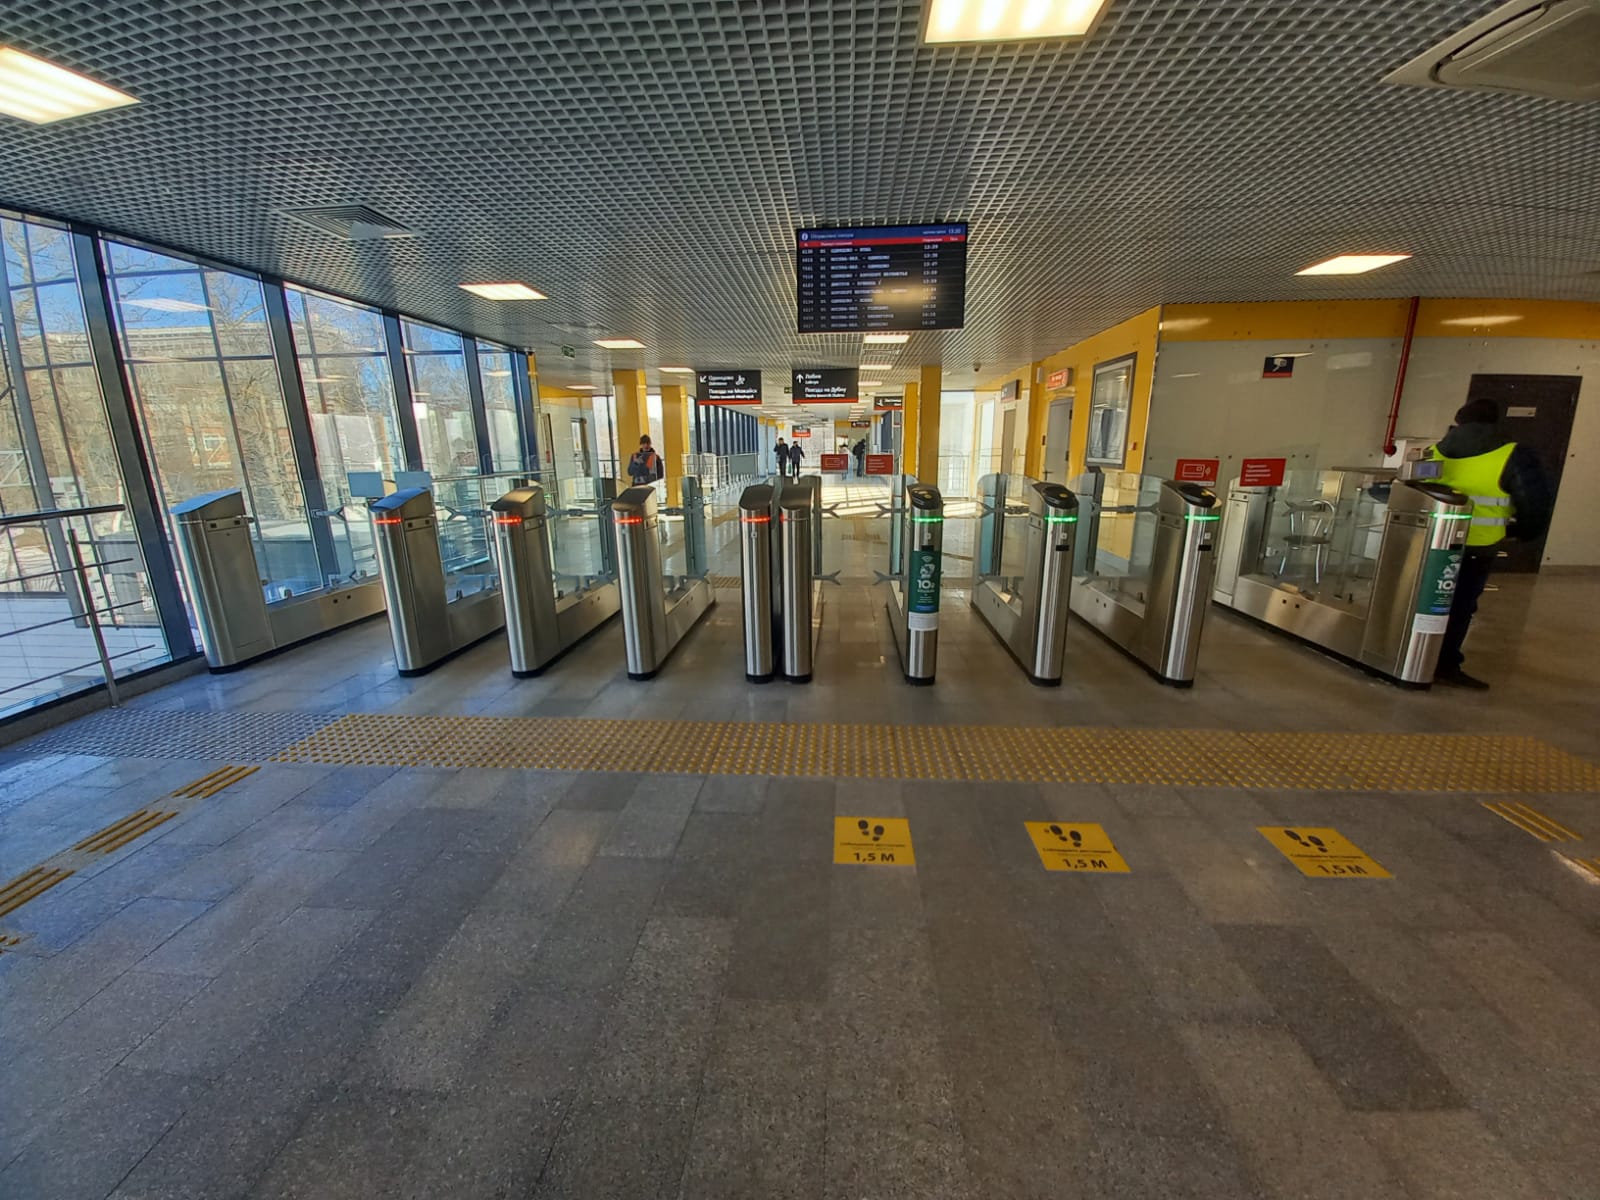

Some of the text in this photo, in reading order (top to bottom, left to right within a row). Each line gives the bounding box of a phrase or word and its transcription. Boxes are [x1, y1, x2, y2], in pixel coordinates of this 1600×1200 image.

[854, 852, 876, 862] 1,5
[1062, 859, 1087, 869] 1,5
[1318, 864, 1346, 875] 1,5
